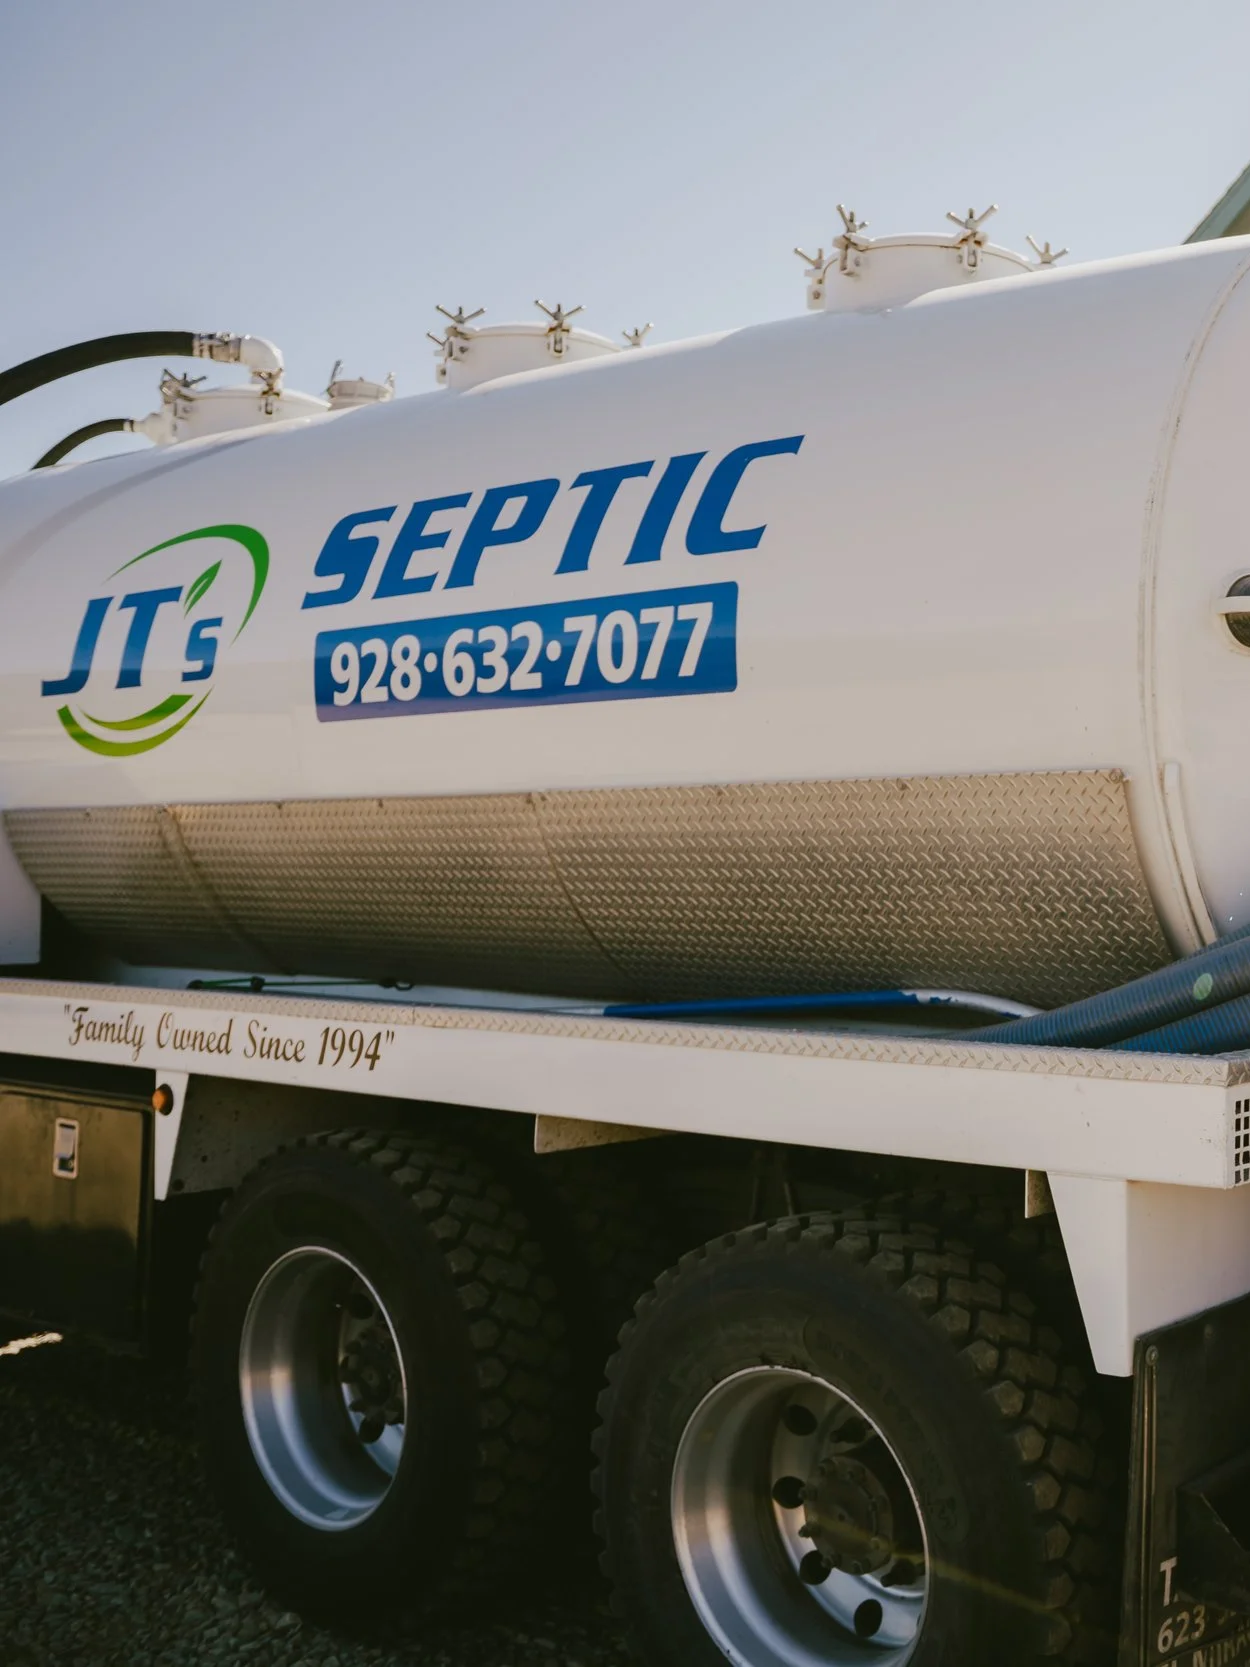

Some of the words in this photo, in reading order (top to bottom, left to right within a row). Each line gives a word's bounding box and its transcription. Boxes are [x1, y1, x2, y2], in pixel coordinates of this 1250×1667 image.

[301, 435, 806, 609] SEPTIC
[156, 1012, 234, 1056] Owned
[243, 1019, 306, 1062] Since
[1157, 1604, 1206, 1654] 623
